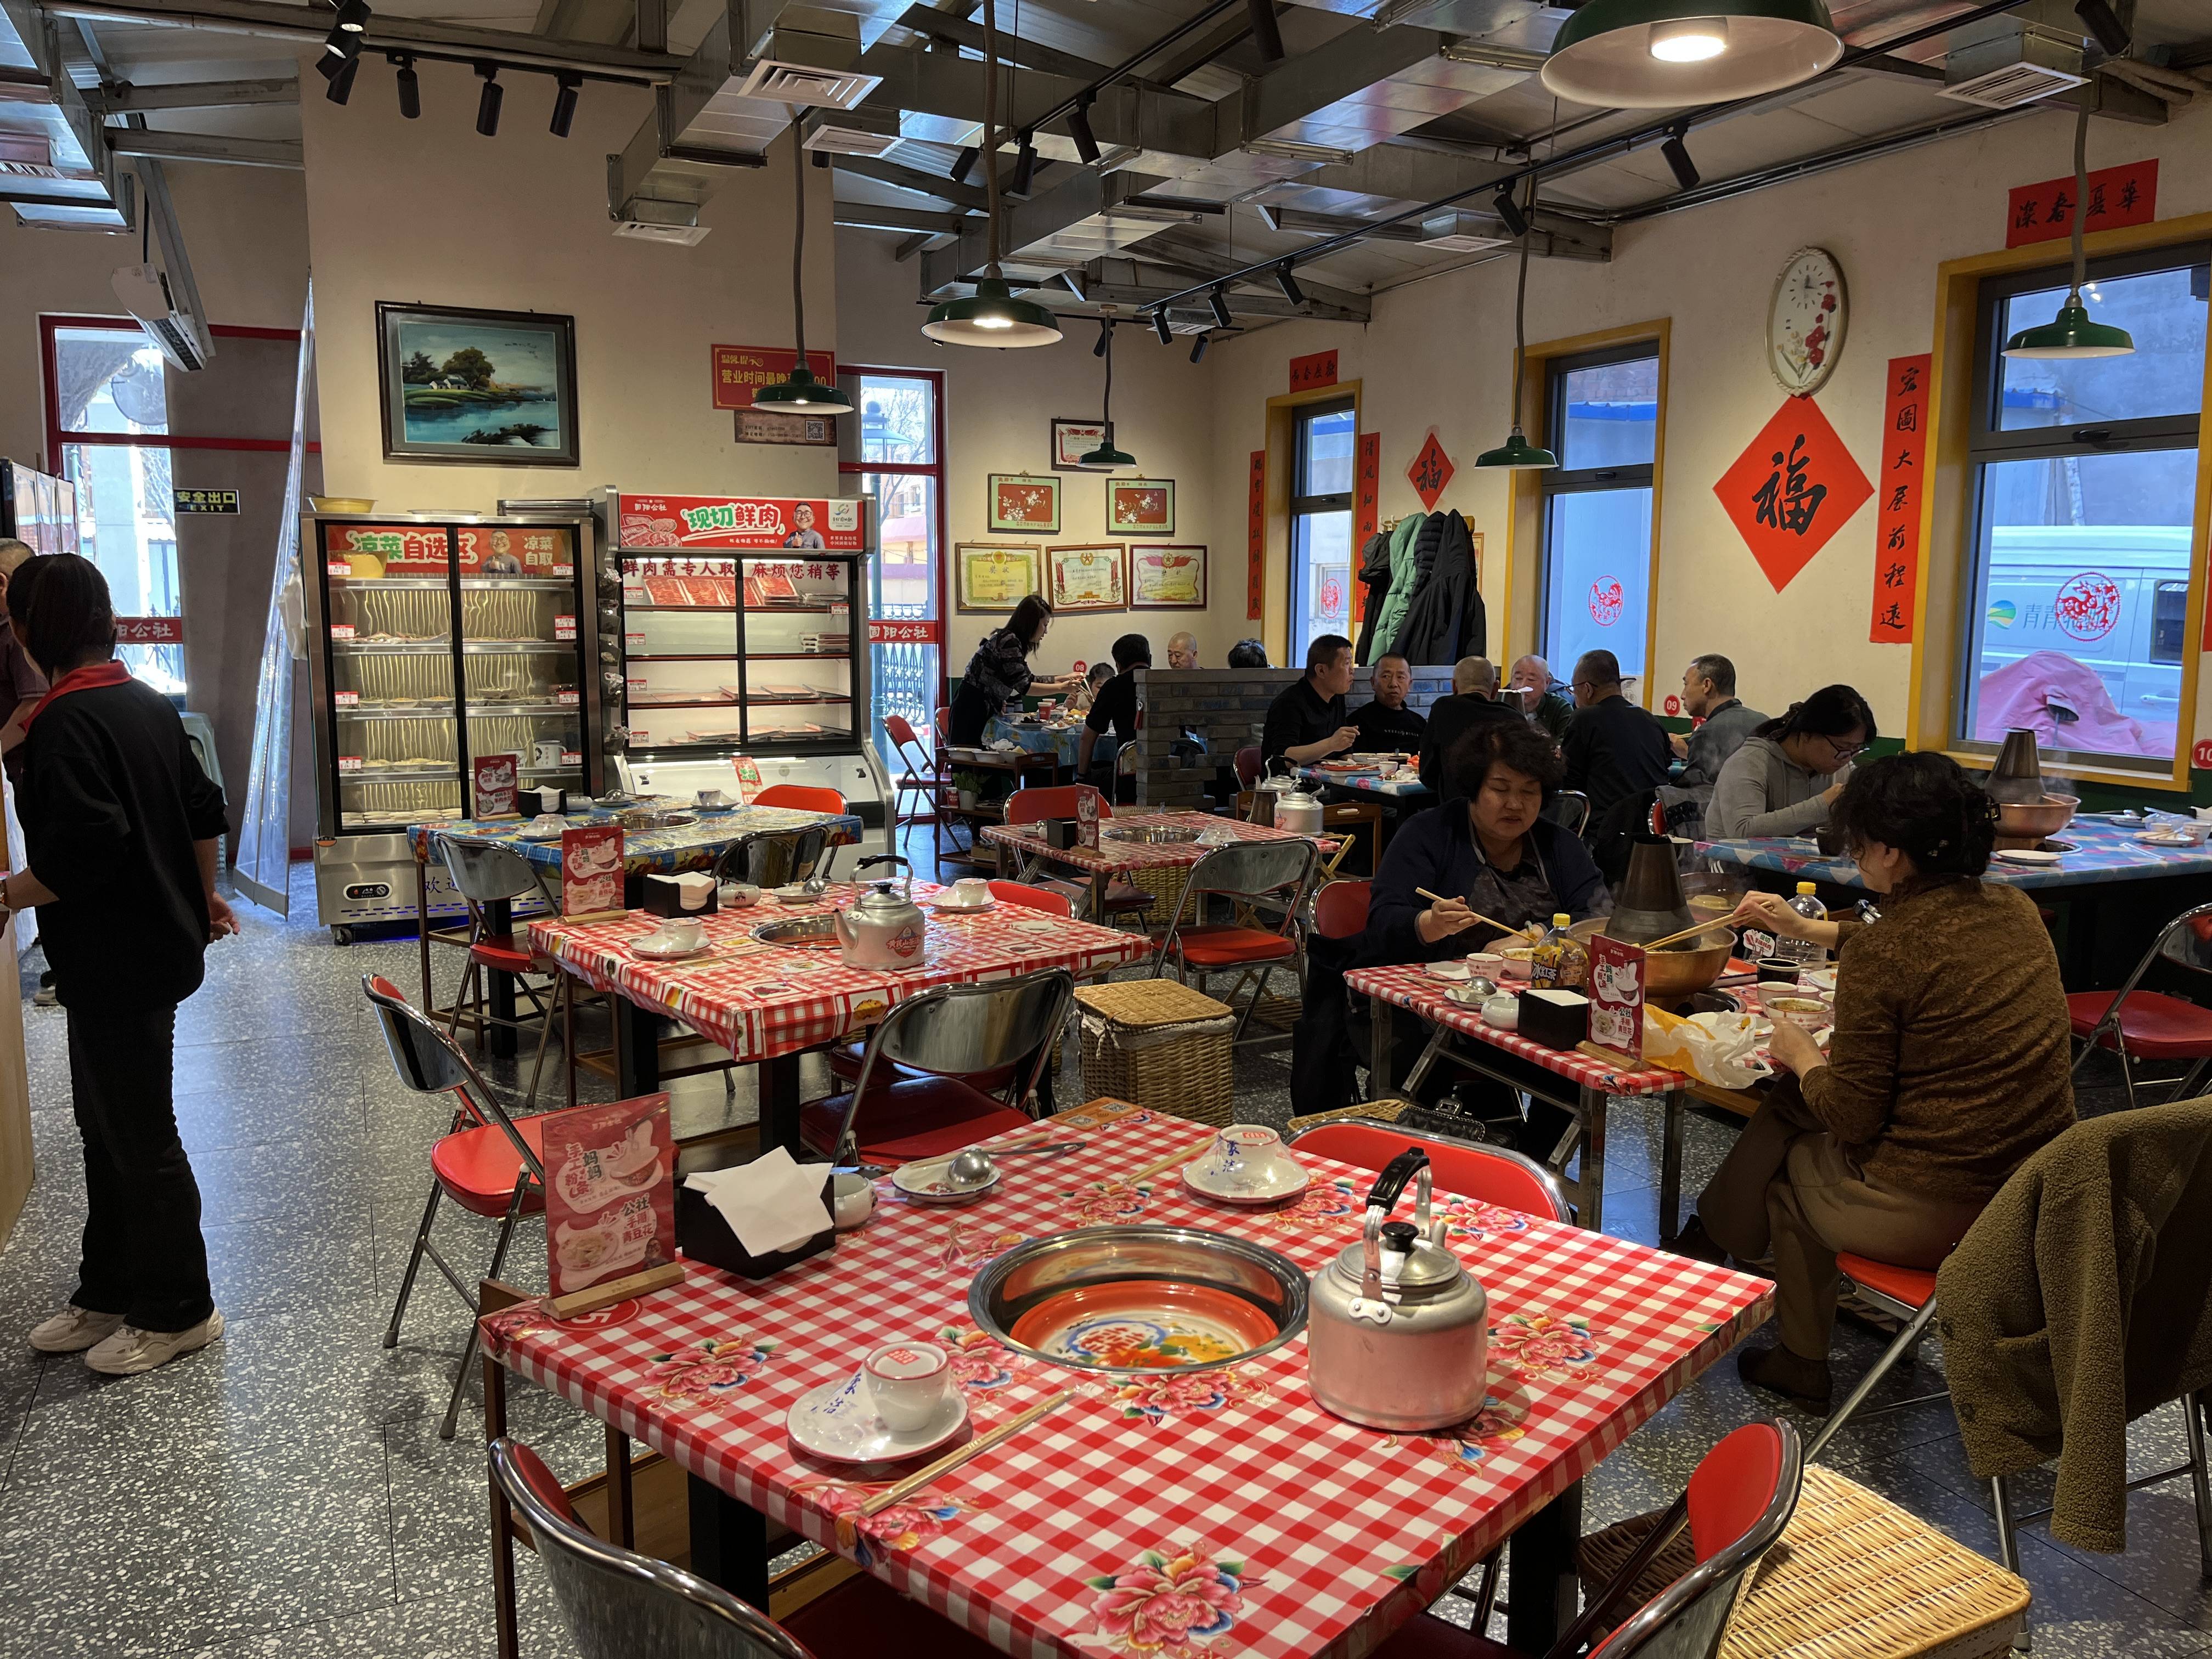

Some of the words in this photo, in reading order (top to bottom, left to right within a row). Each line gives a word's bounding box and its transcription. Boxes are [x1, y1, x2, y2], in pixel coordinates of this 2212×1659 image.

[1417, 448, 1443, 492] 福
[1752, 433, 1827, 537] 福
[177, 490, 236, 504] 安全出口
[687, 505, 779, 530] 现切鲜肉
[354, 534, 472, 562] 凉菜自选区
[523, 535, 554, 550] 凉菜
[524, 552, 552, 566] 自取
[622, 559, 736, 577] 鲜肉需专人取
[752, 561, 840, 582] 麻烦您稍等
[868, 625, 929, 640] 固阳公社
[1075, 664, 1085, 672] 08
[1666, 699, 1677, 711] 09
[1619, 1008, 1632, 1018] 公社
[582, 1150, 602, 1180] 妈妈
[620, 1197, 650, 1217] 公社
